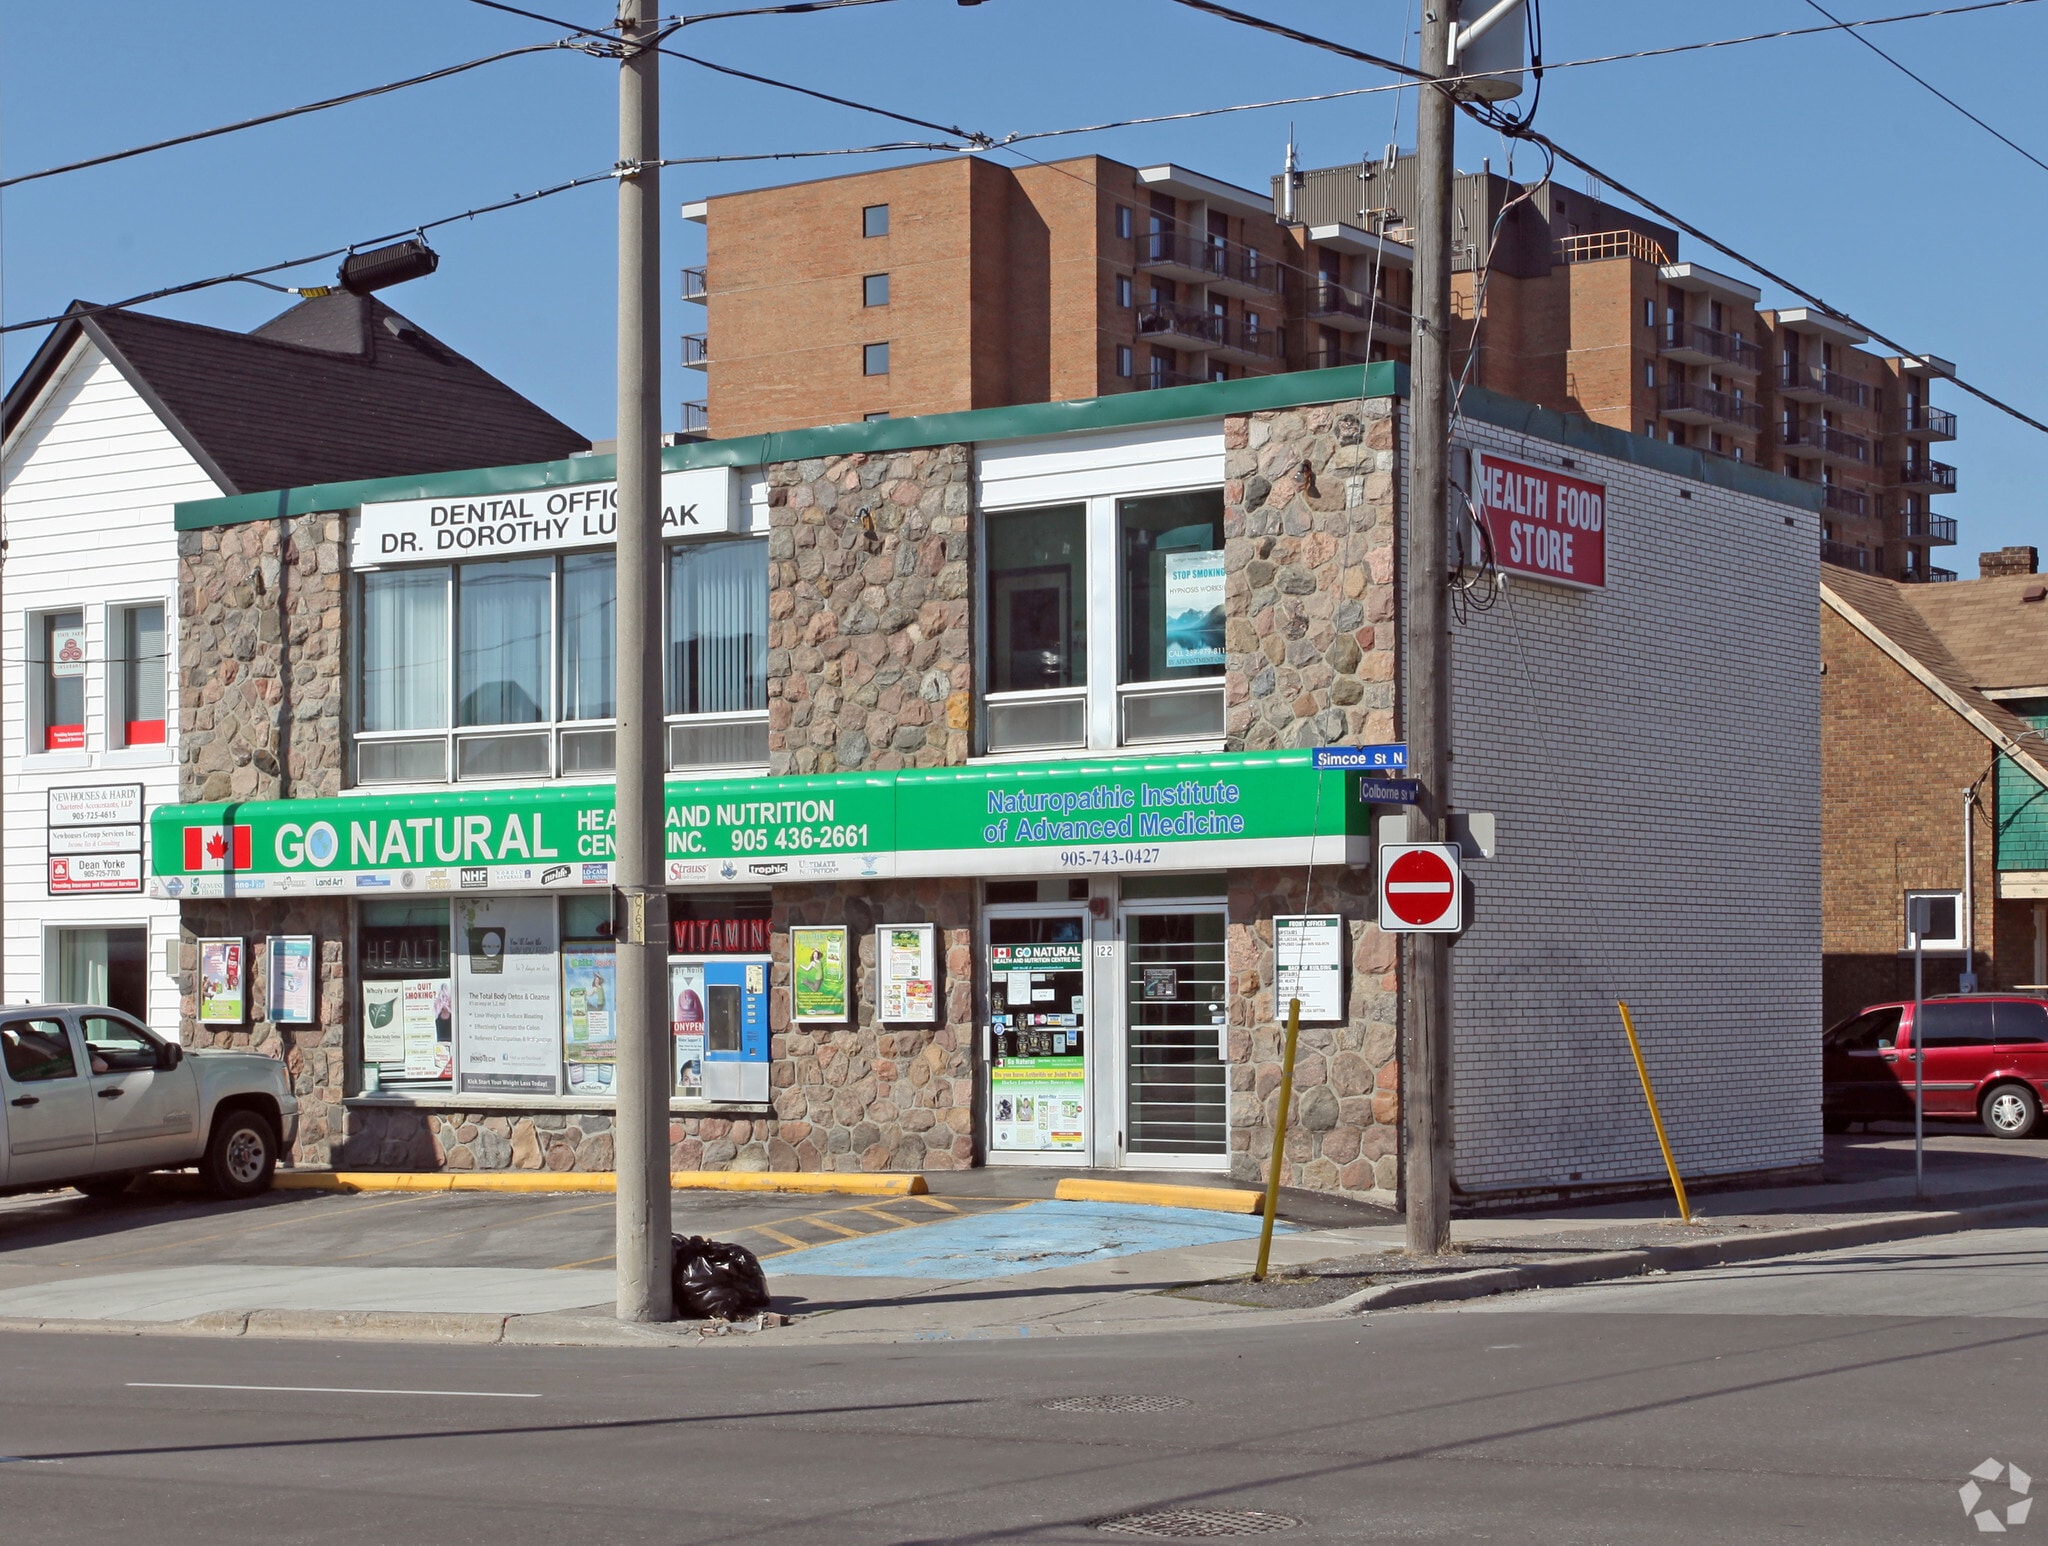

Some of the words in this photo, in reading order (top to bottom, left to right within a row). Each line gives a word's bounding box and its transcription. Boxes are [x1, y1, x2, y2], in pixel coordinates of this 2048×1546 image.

[1480, 462, 1548, 520] HEALTH
[1557, 485, 1602, 533] FOOD
[430, 497, 534, 527] DENTAL
[546, 487, 617, 516] OFFIC
[381, 531, 423, 554] DR.
[436, 517, 569, 550] DOROTHY
[583, 503, 701, 537] LUAK
[1509, 521, 1574, 575] STORE
[1172, 570, 1191, 580] STOP
[1192, 567, 1226, 578] SMOKING
[1169, 586, 1199, 595] HYPNOSIS
[1168, 649, 1184, 658] CALL
[1185, 647, 1225, 657] 289-979-811
[1317, 753, 1366, 766] Simcoe
[1373, 753, 1387, 764] St
[1393, 752, 1403, 764] N
[52, 791, 100, 802] NEWHOUSES
[101, 790, 108, 800] &
[109, 789, 138, 800] HARDY
[1362, 783, 1399, 800] Colborne
[1400, 789, 1408, 801] St
[987, 783, 1134, 817] Naturopathic
[1141, 780, 1239, 807] Institute
[56, 803, 83, 811] Chartered
[121, 800, 133, 808] LLP
[577, 808, 616, 831] HEA
[665, 805, 711, 828] AND
[716, 800, 835, 827] NUTRITION
[983, 820, 1007, 843] of
[1015, 814, 1132, 842] Advanced
[1139, 811, 1244, 837] Medicine
[83, 831, 100, 840] Group
[102, 830, 124, 838] Services
[274, 820, 339, 868] GO
[350, 812, 558, 865] NATURAL
[577, 834, 616, 856] CEN
[667, 831, 707, 853] INC.
[731, 829, 768, 851] 905
[774, 824, 869, 849] 436-2661
[1060, 848, 1160, 867] 905-743-0427
[79, 860, 100, 870] Dean
[102, 859, 126, 869] Yorke
[750, 865, 786, 875] trophic
[798, 860, 836, 868] UTIMATE
[84, 869, 121, 878] 905-725-7700
[461, 870, 487, 882] NHF
[669, 862, 707, 881] Strauss
[315, 878, 332, 887] Land
[332, 878, 343, 886] Art
[674, 918, 774, 953] VITAMINS
[366, 939, 451, 969] HEALTH
[1015, 947, 1031, 958] GO
[1033, 946, 1081, 957] NATURAL
[1097, 946, 1113, 956] 122
[417, 982, 432, 991] QUIT
[404, 990, 437, 1000] SMOKING?
[469, 992, 479, 1000] The
[479, 992, 493, 1000] Total
[493, 992, 507, 1002] Body
[507, 993, 524, 1001] Detox
[524, 993, 529, 1001] &
[529, 993, 550, 1001] Cleanse
[673, 1022, 705, 1032] ONYPEN
[531, 1080, 548, 1088] Today!
